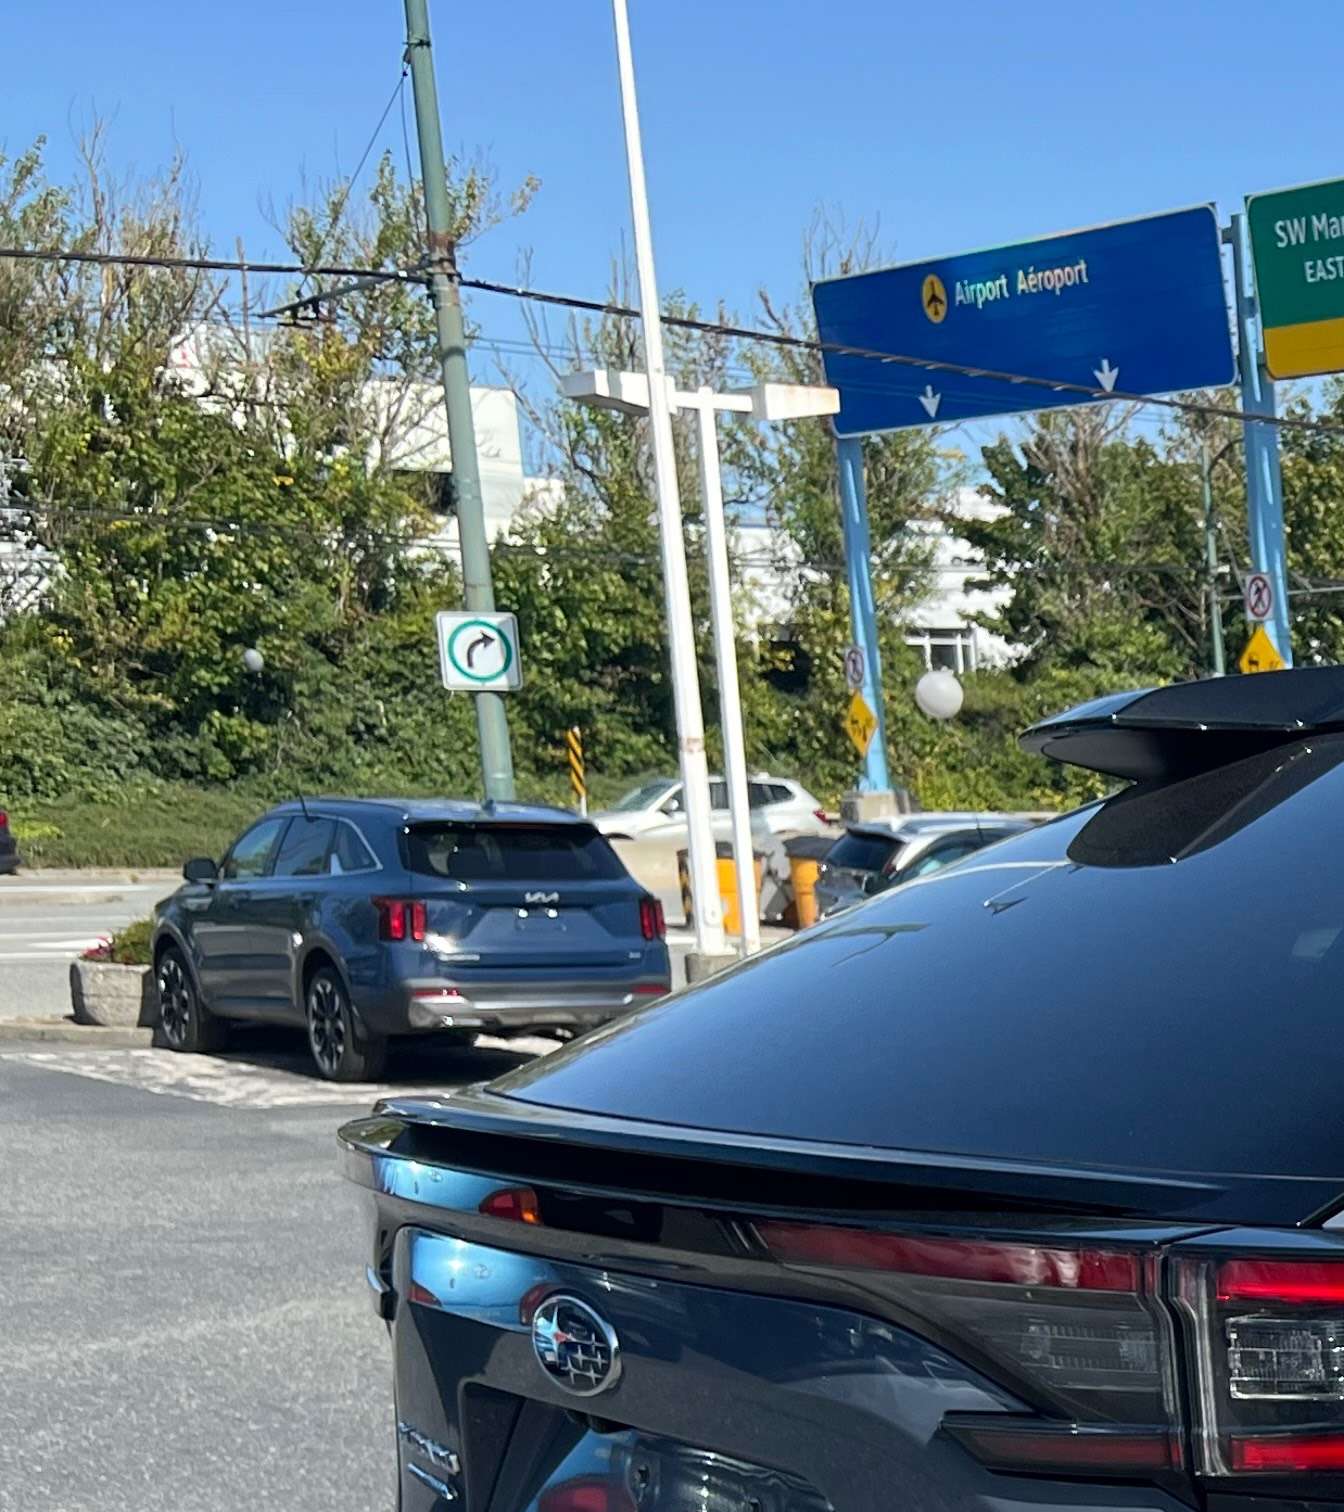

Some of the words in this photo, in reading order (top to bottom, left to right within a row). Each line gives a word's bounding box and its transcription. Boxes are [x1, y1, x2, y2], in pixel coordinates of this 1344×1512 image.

[1274, 216, 1306, 248] SW
[955, 274, 1009, 309] Airport
[1017, 259, 1089, 295] Aéroport
[1304, 255, 1344, 283] EAST
